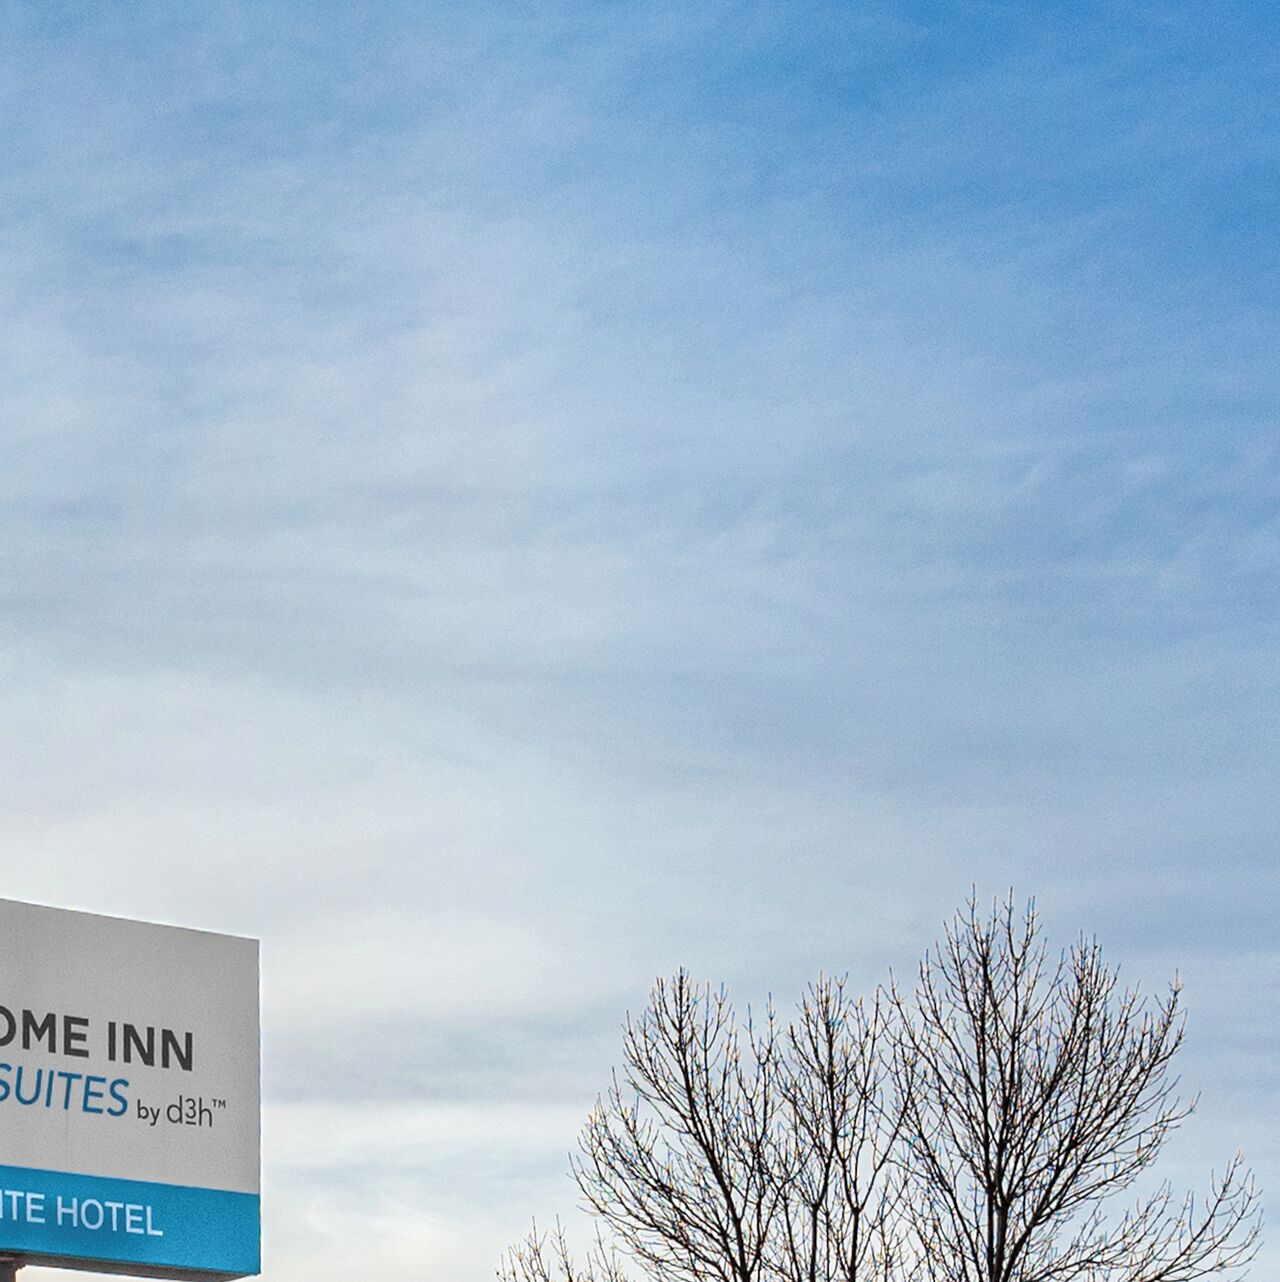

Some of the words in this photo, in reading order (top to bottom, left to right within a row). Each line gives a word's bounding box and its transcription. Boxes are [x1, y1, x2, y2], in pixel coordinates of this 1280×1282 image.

[108, 1021, 193, 1072] INN
[137, 1099, 160, 1126] by
[56, 1196, 163, 1236] HOTEL
